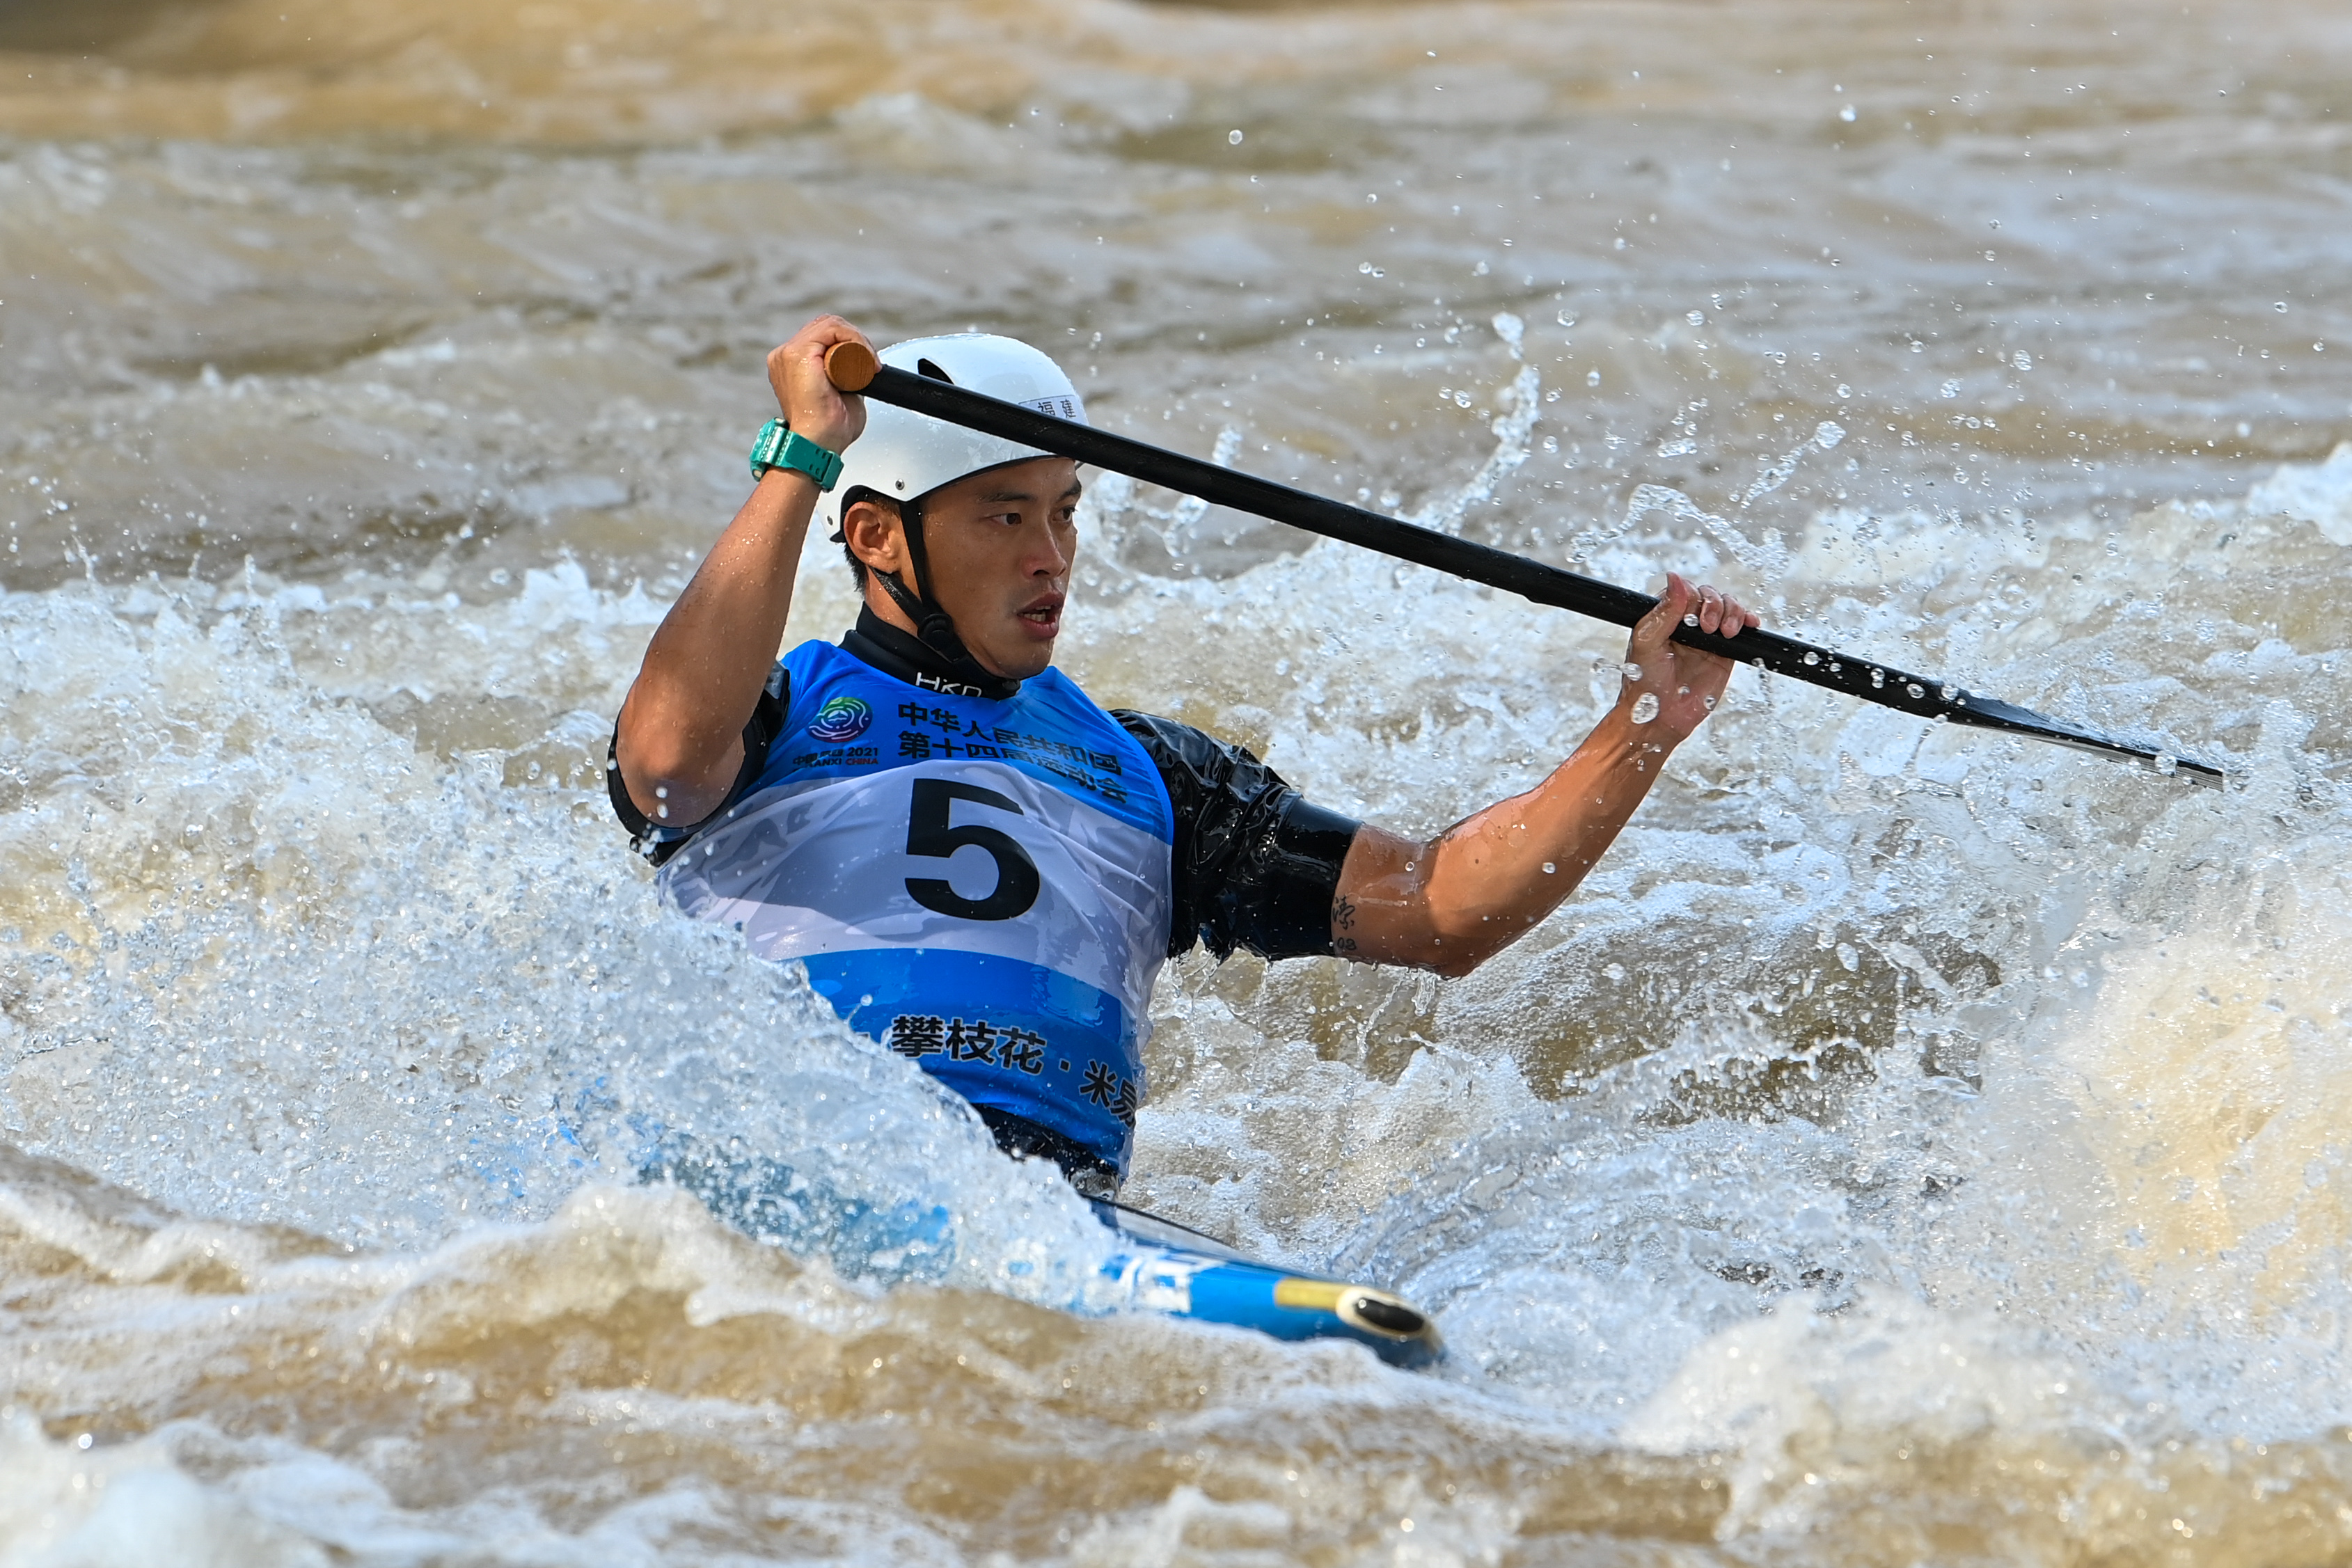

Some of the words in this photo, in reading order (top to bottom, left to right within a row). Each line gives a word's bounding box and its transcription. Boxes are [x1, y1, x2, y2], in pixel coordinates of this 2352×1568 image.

[1038, 398, 1077, 418] 福建
[898, 702, 1122, 776] 中华人民共和国
[846, 747, 879, 757] 2021
[846, 757, 878, 766] CHINA
[905, 777, 1041, 921] 5
